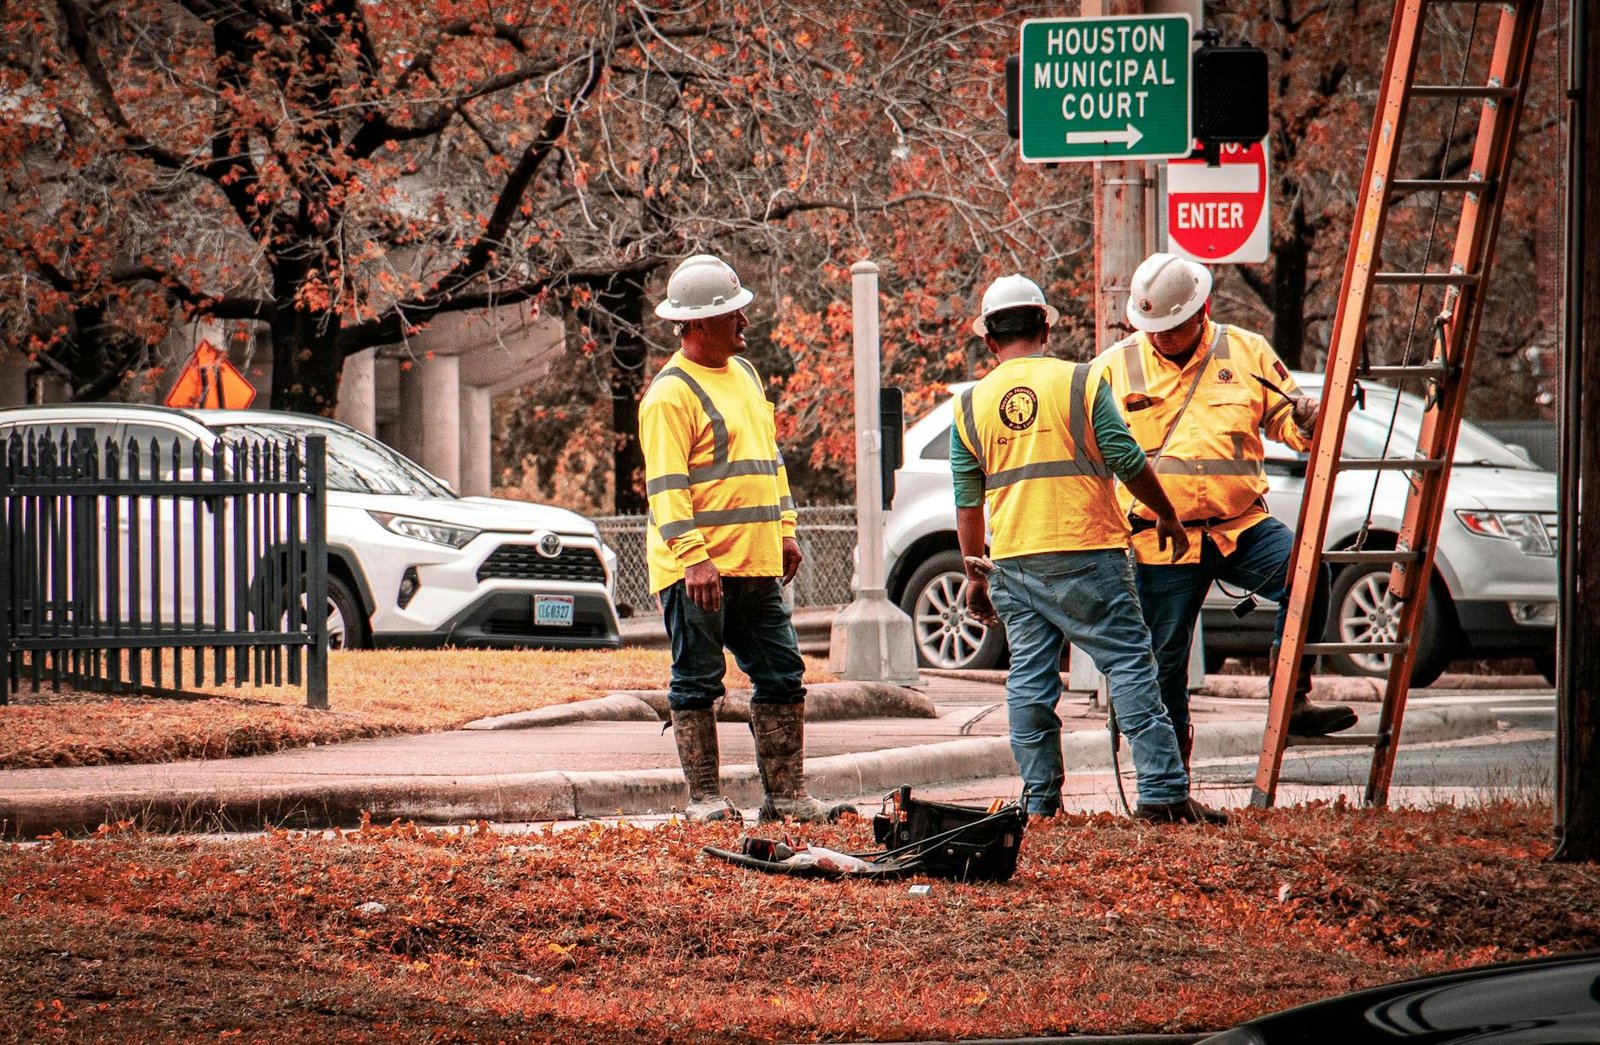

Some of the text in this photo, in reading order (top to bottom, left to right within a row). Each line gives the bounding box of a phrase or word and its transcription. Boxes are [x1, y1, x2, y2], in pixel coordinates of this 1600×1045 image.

[1047, 25, 1166, 56] HOUSTON
[1034, 58, 1176, 89] MUNICIPAL
[1061, 91, 1149, 120] COURT
[1177, 202, 1244, 230] ENTER
[1000, 391, 1013, 410] North
